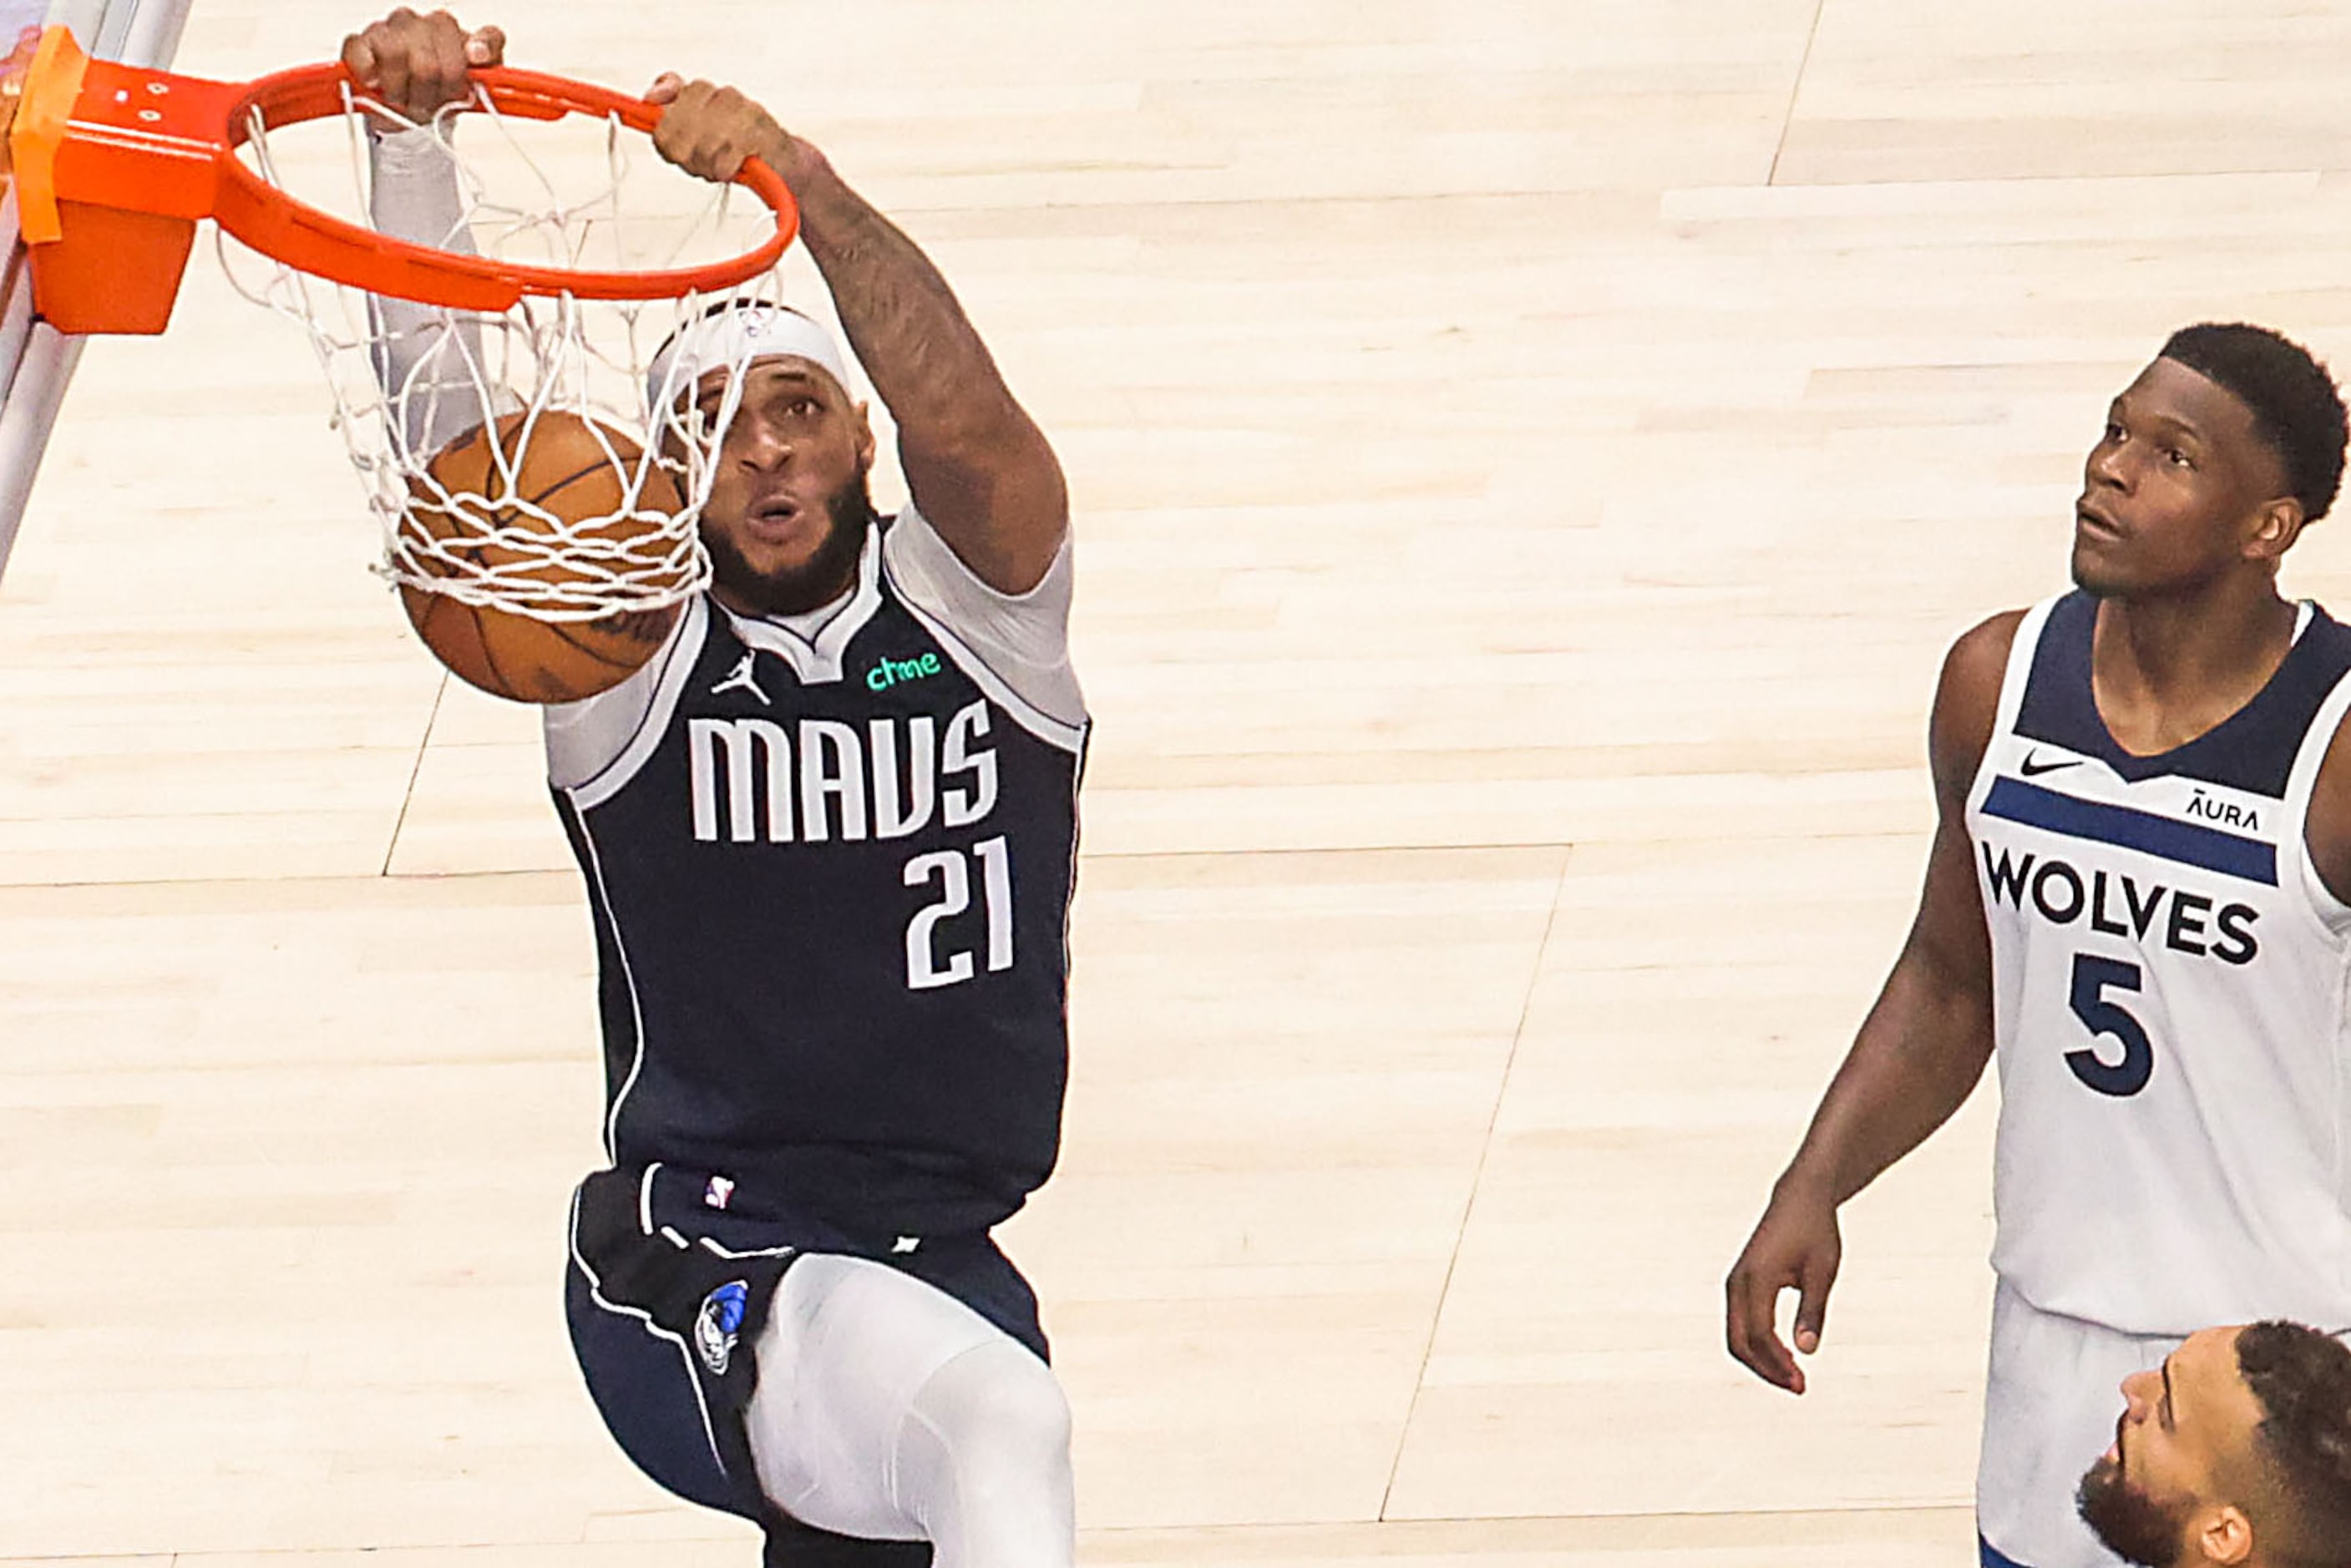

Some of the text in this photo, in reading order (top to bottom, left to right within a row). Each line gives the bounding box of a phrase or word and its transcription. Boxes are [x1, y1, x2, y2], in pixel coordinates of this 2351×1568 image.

[688, 698, 999, 842] MAVS
[904, 835, 1013, 989] 21
[1982, 841, 2260, 965] WOLVES
[2064, 952, 2154, 1097] 5
